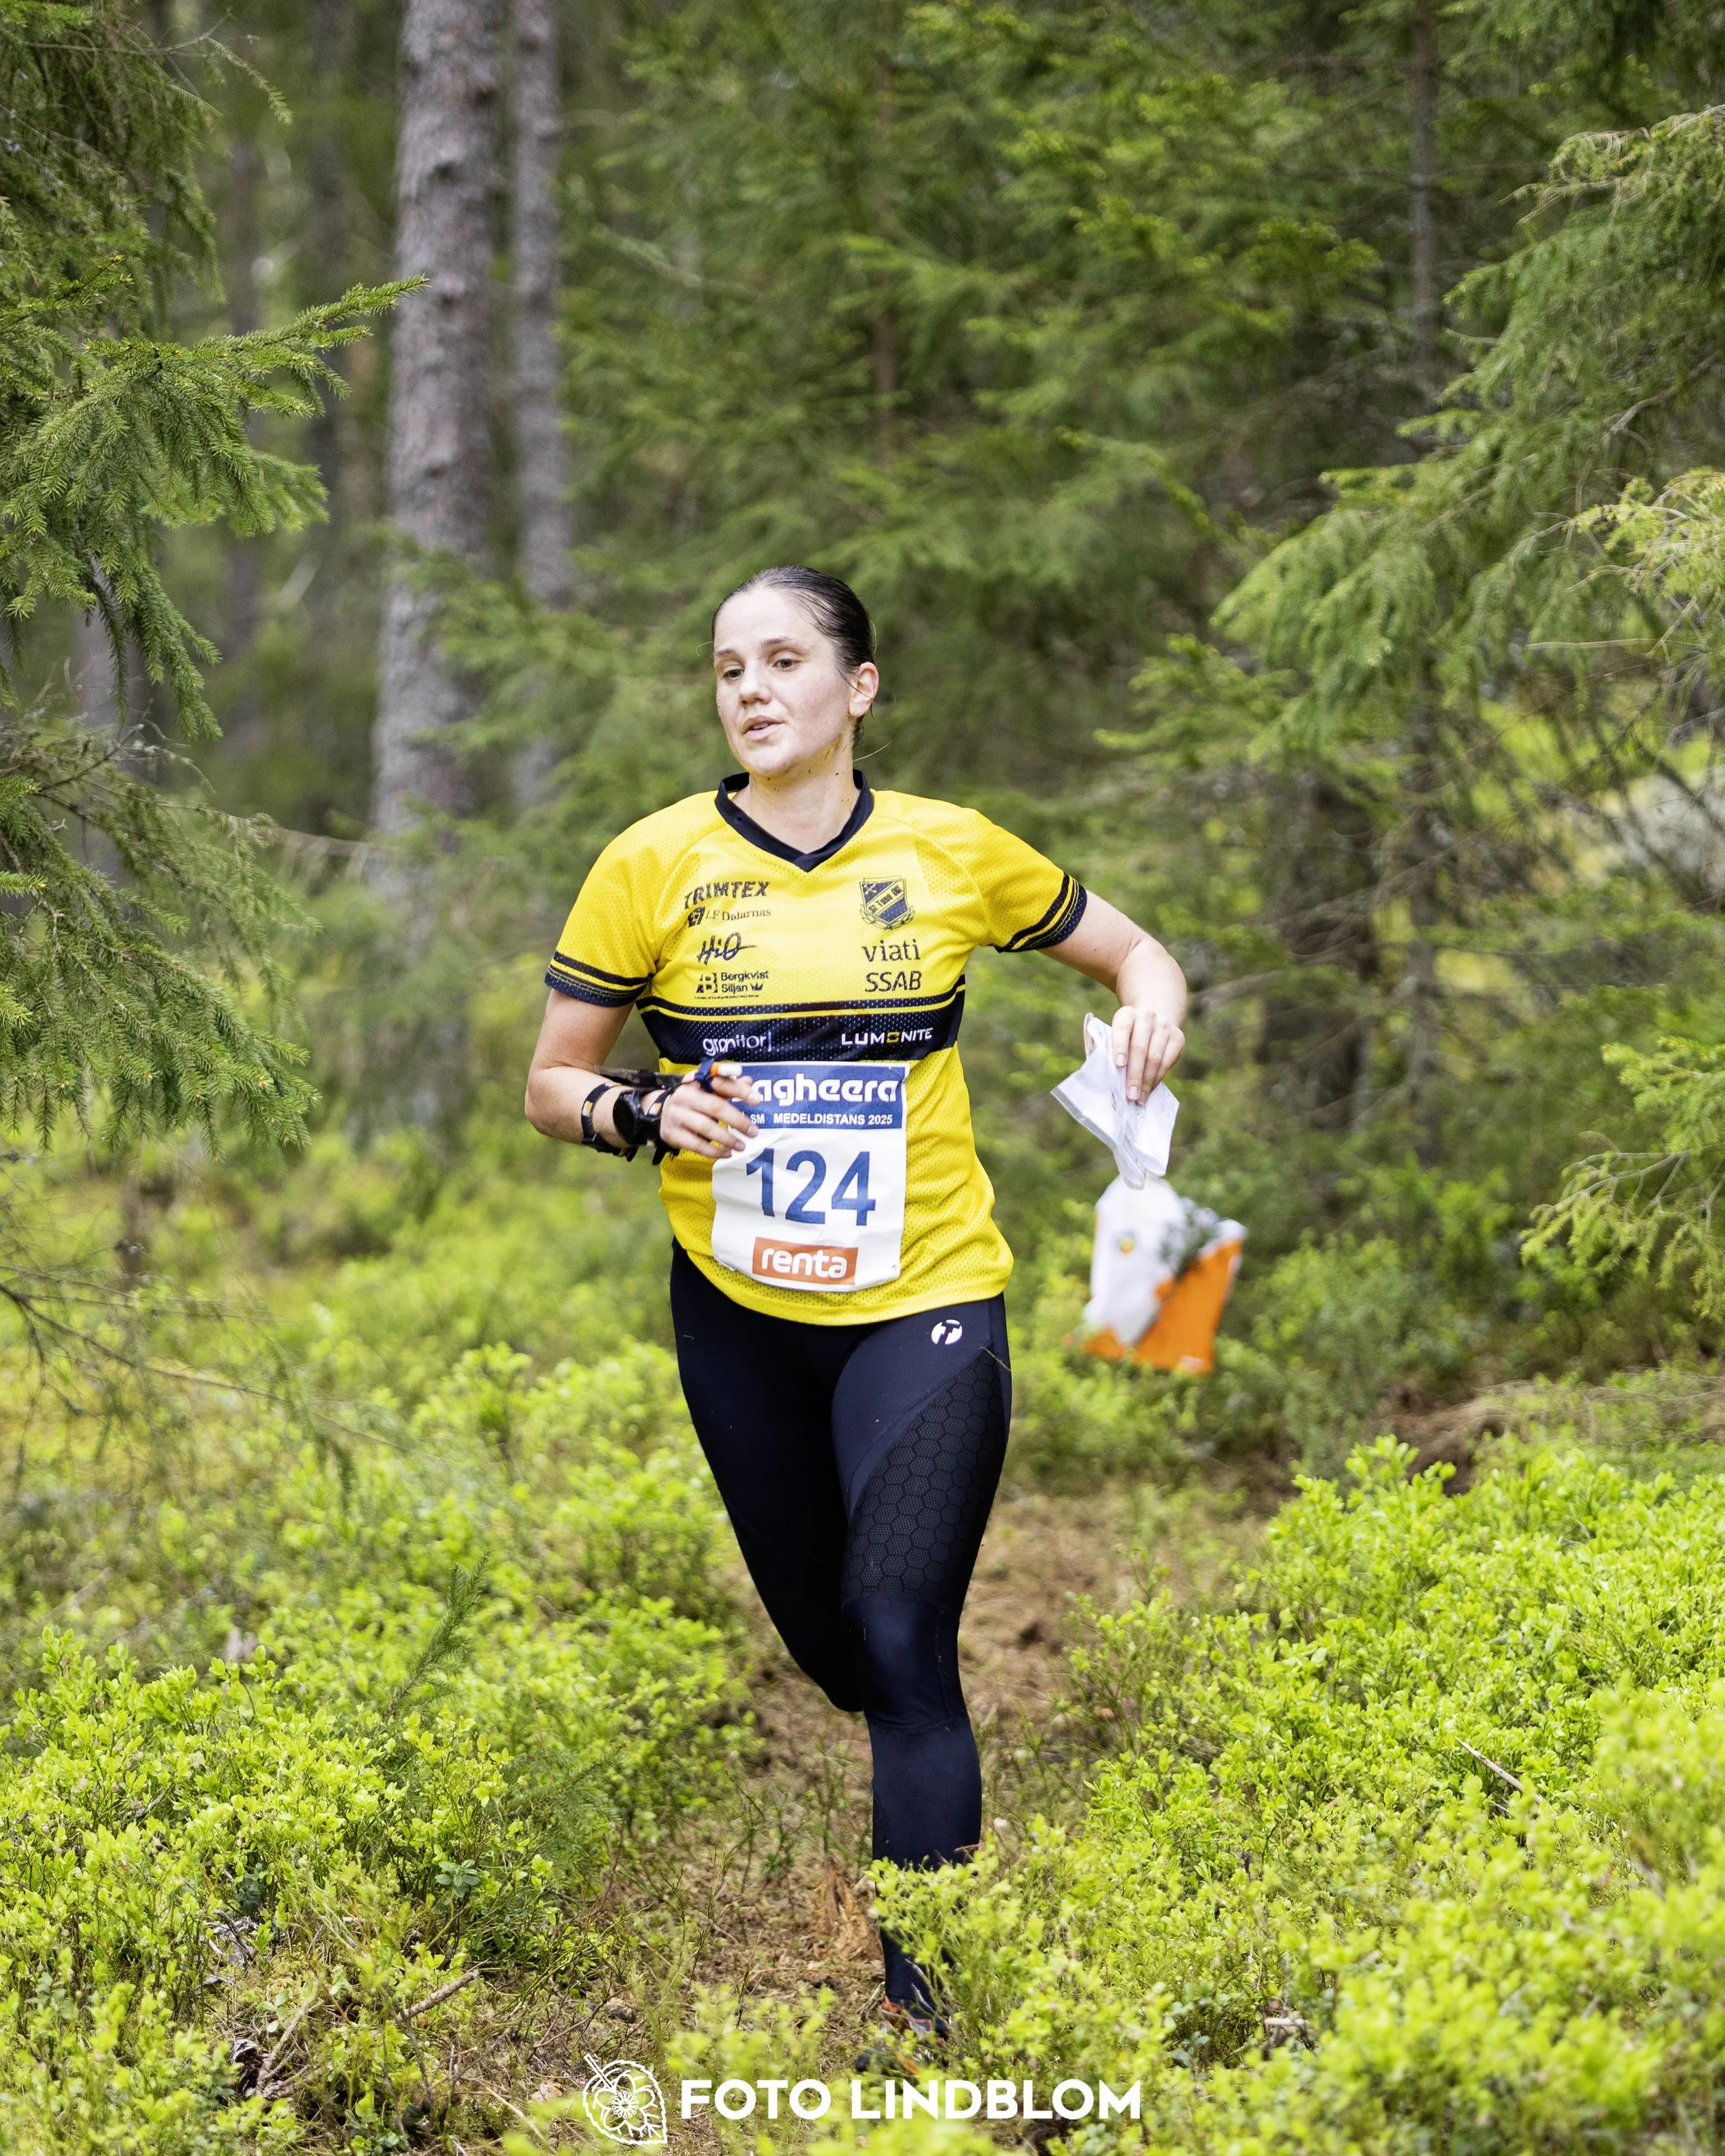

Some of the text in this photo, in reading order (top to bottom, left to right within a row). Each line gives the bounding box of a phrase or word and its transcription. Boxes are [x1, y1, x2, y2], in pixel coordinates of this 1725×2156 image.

[684, 880, 771, 909] TRIMTEX
[722, 909, 771, 921] Dalarnas
[861, 938, 920, 962] viati
[721, 970, 769, 982] Bergkvist
[865, 971, 922, 992] SSAB
[721, 983, 748, 993] Siljan
[841, 1027, 934, 1046] LUMONITE
[731, 1074, 899, 1107] agheera
[751, 1113, 893, 1125] SM MEDELDISTANS 2025
[746, 1148, 876, 1226] 124
[761, 1247, 848, 1279] renta
